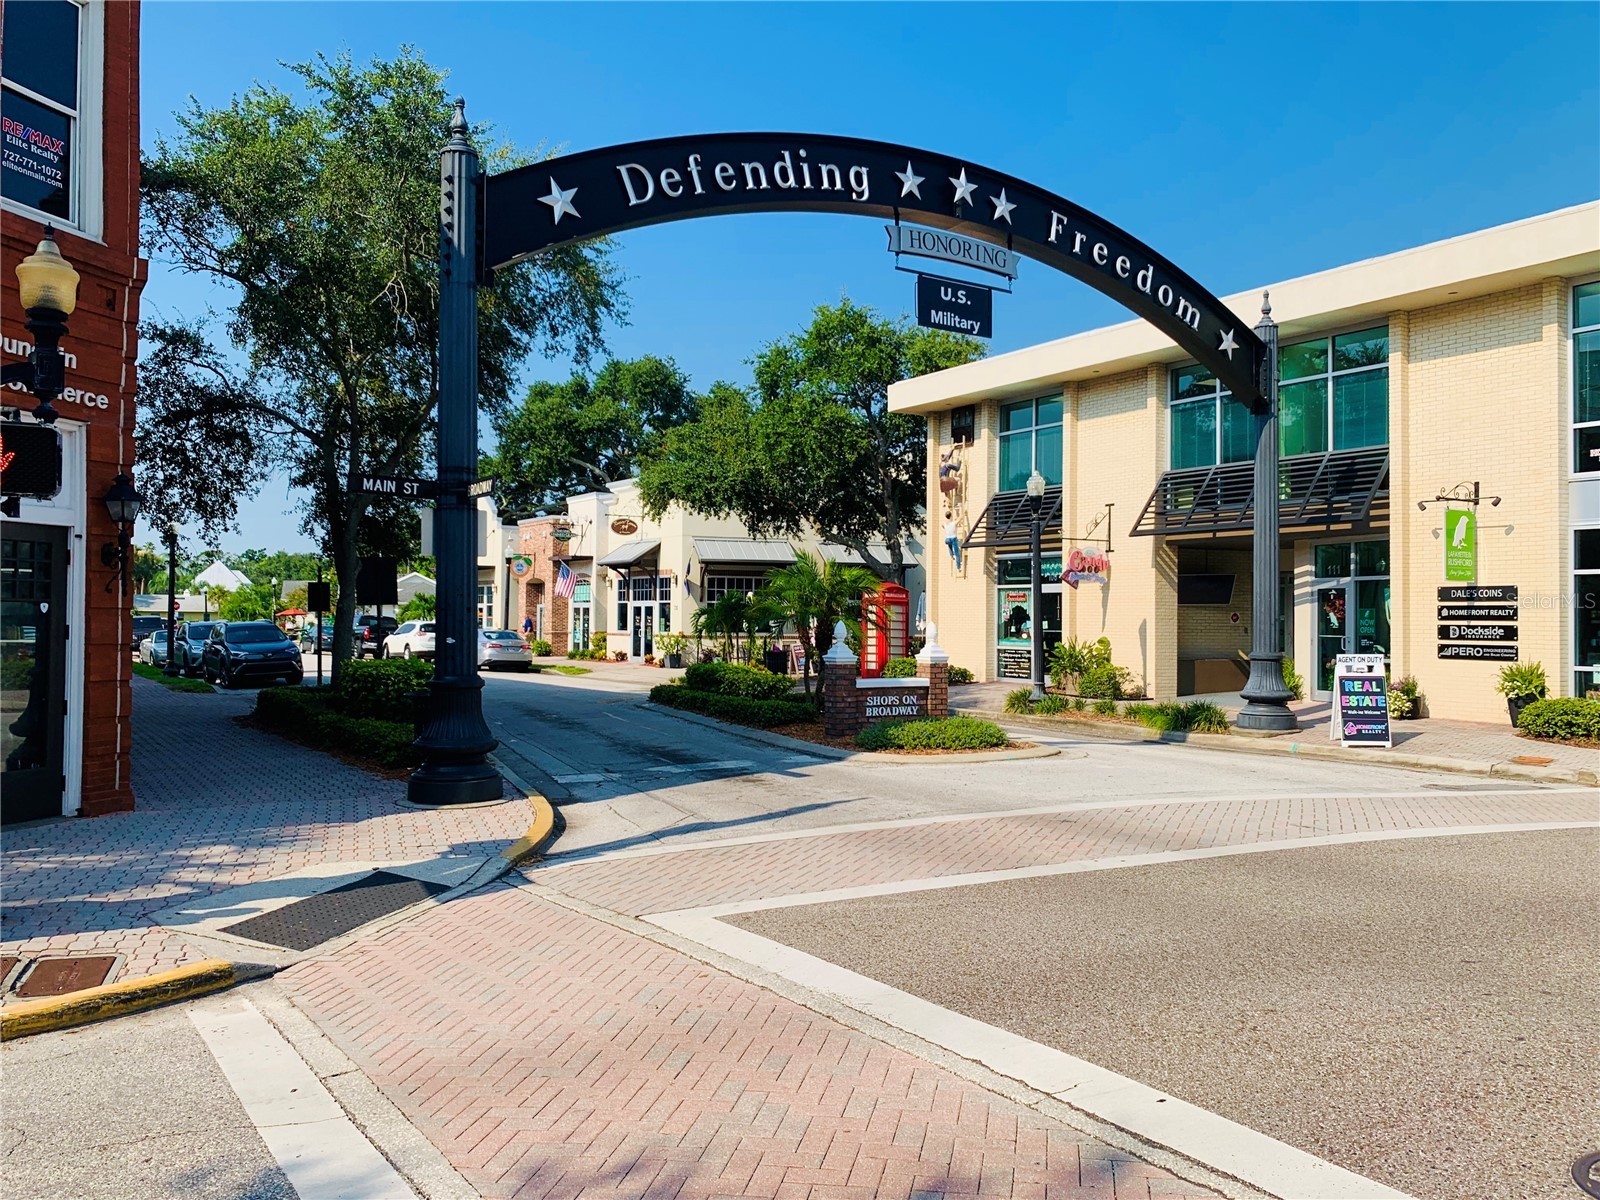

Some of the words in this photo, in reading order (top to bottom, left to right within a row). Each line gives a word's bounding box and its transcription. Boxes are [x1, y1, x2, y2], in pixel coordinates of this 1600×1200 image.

[2, 117, 64, 155] RE/MAX
[6, 134, 29, 150] Elite
[31, 144, 59, 163] Realty
[3, 149, 62, 179] 727-771-1072
[2, 161, 63, 188] eliteonmain.com
[616, 149, 869, 207] Defending
[1048, 210, 1201, 332] Freedom
[909, 230, 1007, 269] HONORING
[941, 286, 971, 305] U.S.
[930, 309, 980, 334] Military
[363, 478, 396, 493] MAIN
[403, 482, 419, 495] ST
[1451, 590, 1477, 598] DALE'S
[1478, 589, 1503, 597] COINS
[1461, 626, 1504, 636] Dockside
[1452, 647, 1483, 657] PERO
[1344, 681, 1381, 692] REAL
[866, 696, 899, 706] SHOPS
[902, 695, 917, 705] ON
[1341, 695, 1386, 707] ESTATE
[865, 705, 919, 717] BROADWAY
